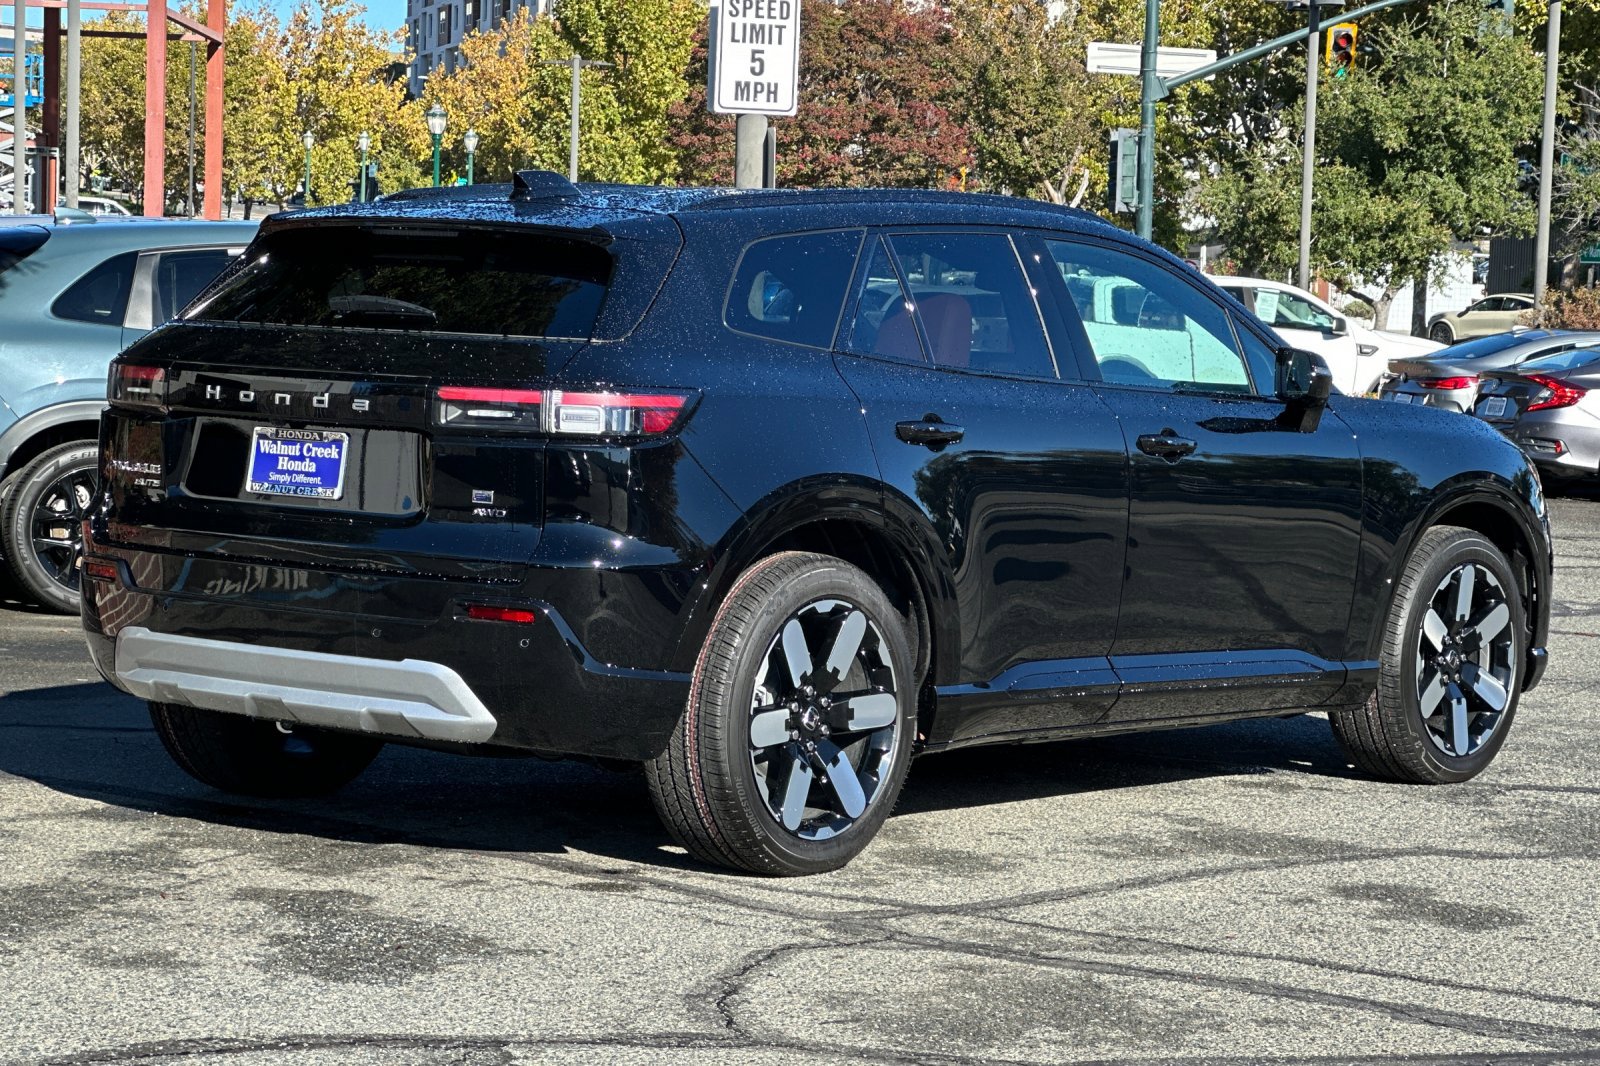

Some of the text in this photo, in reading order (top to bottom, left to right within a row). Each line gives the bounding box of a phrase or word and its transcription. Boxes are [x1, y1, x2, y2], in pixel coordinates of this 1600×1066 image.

[728, 0, 791, 20] SPEED
[731, 22, 787, 45] LIMIT
[749, 49, 765, 76] 5
[734, 80, 779, 103] MPH
[277, 430, 321, 440] HONDA
[259, 439, 340, 459] Walnut Creek
[277, 456, 317, 473] Honda
[268, 471, 323, 485] Simply Different.
[252, 482, 335, 497] WALNUT CREEK
[735, 775, 766, 840] BRIDGESTONE
